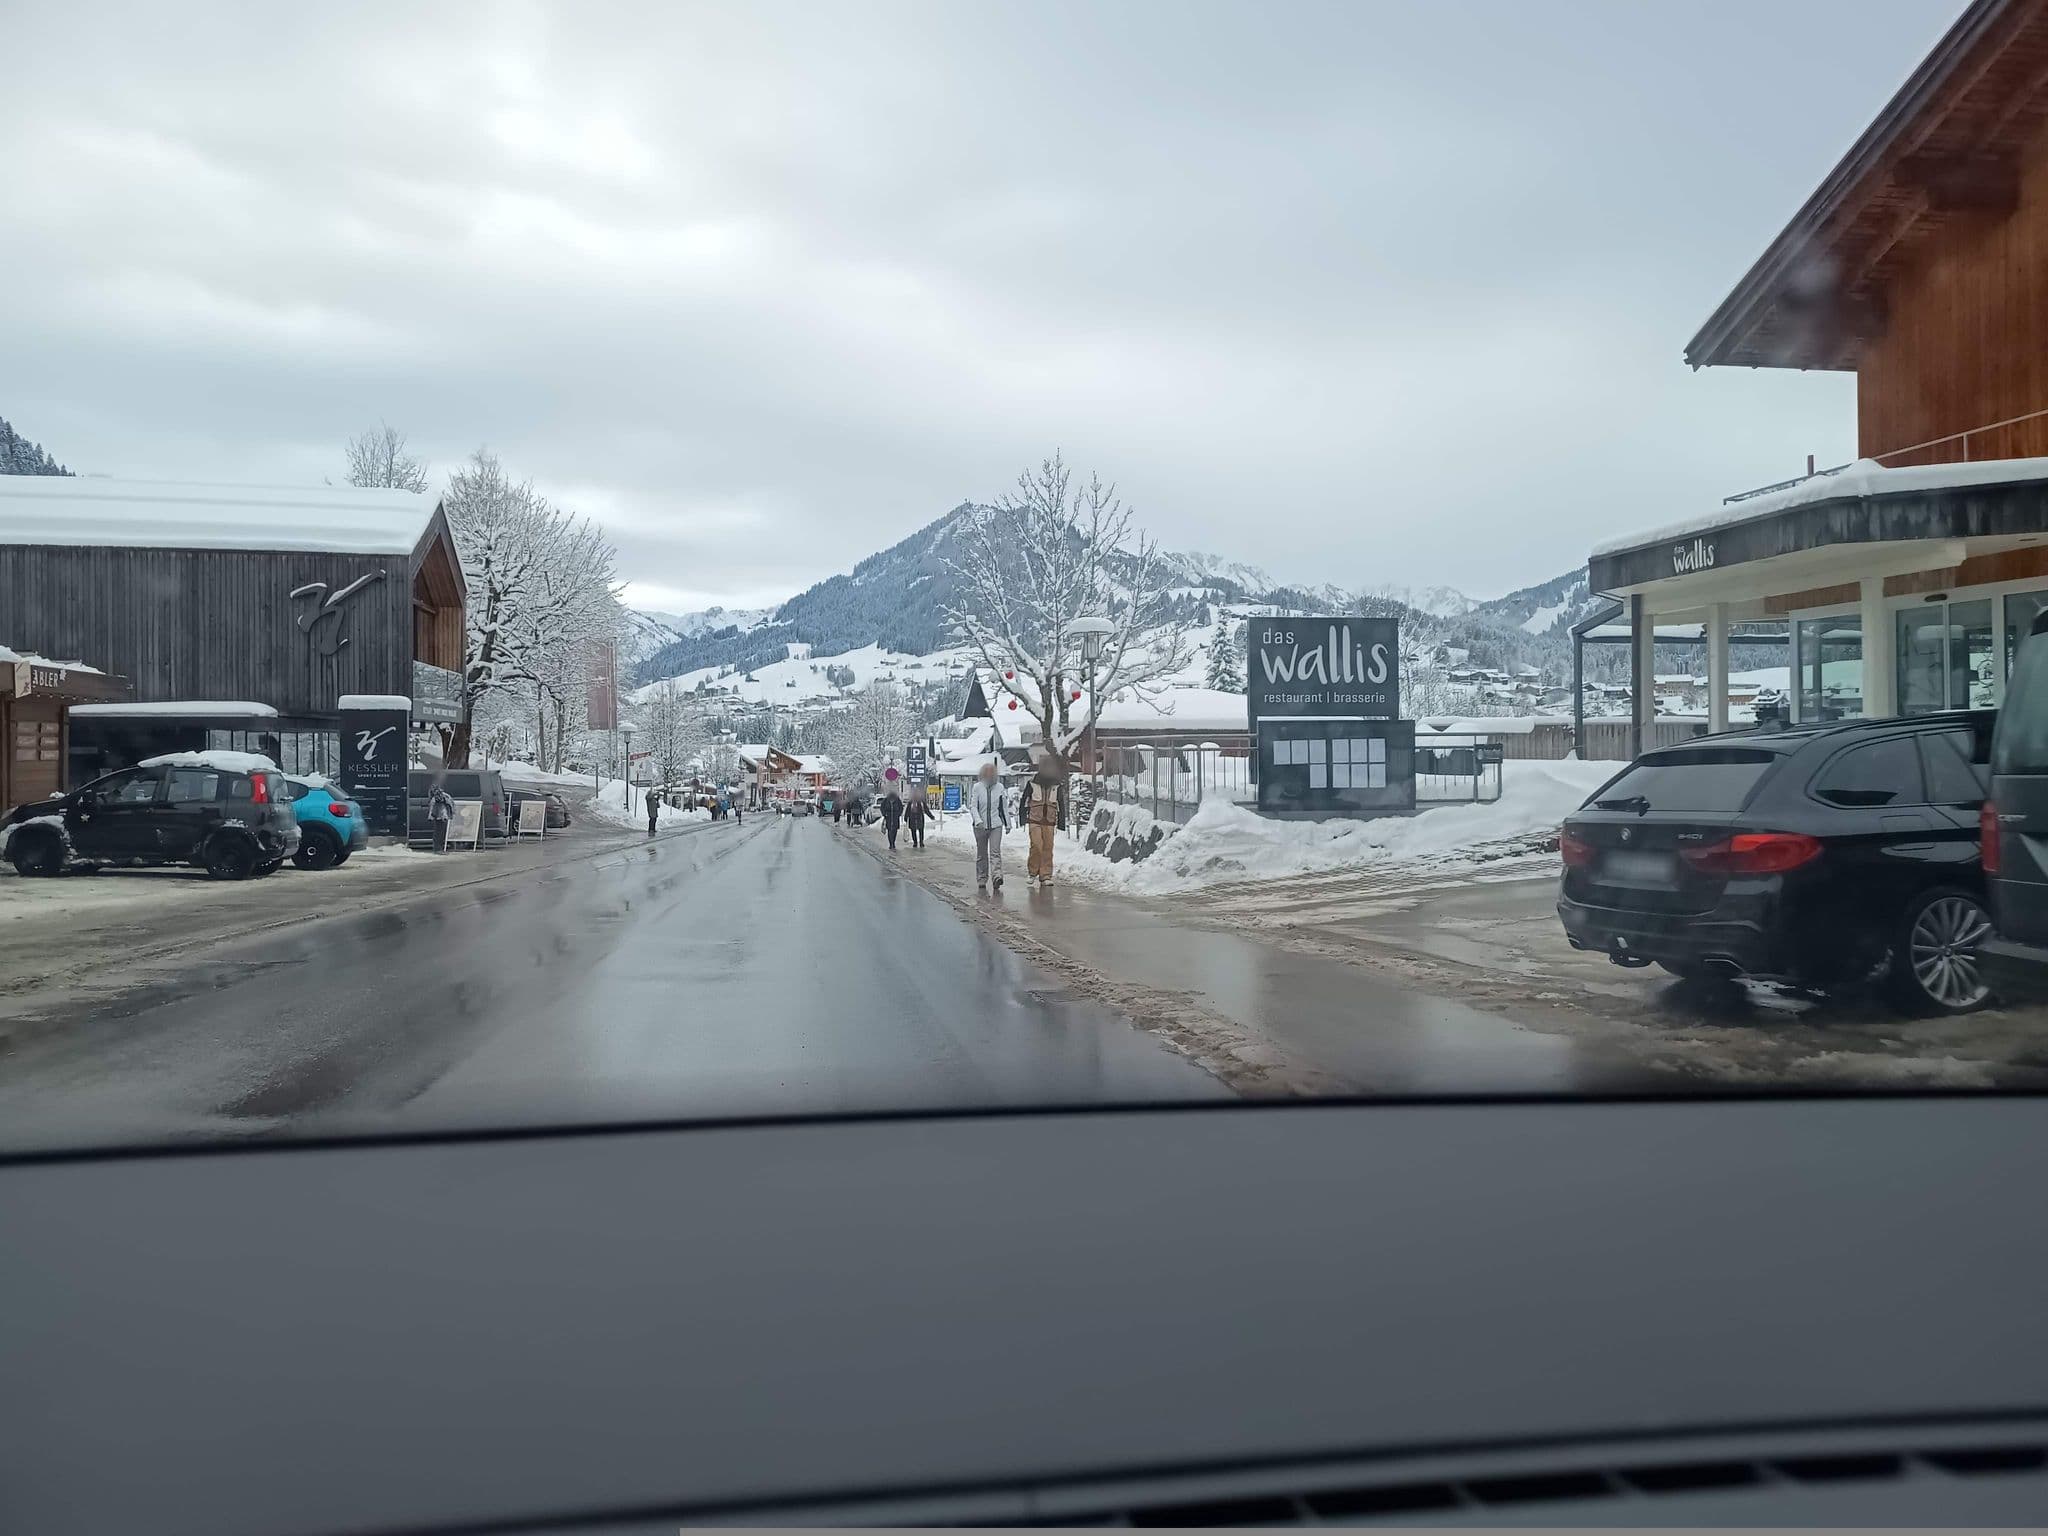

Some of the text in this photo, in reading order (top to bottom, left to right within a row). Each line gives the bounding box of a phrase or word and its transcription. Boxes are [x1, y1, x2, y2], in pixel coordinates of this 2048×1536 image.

[1673, 538, 1715, 573] wallis
[1263, 627, 1295, 644] das
[1260, 625, 1388, 685] wallis
[1264, 692, 1322, 703] restaurant
[1333, 691, 1385, 703] brasserie
[913, 749, 920, 759] P
[348, 763, 398, 772] KESSLER
